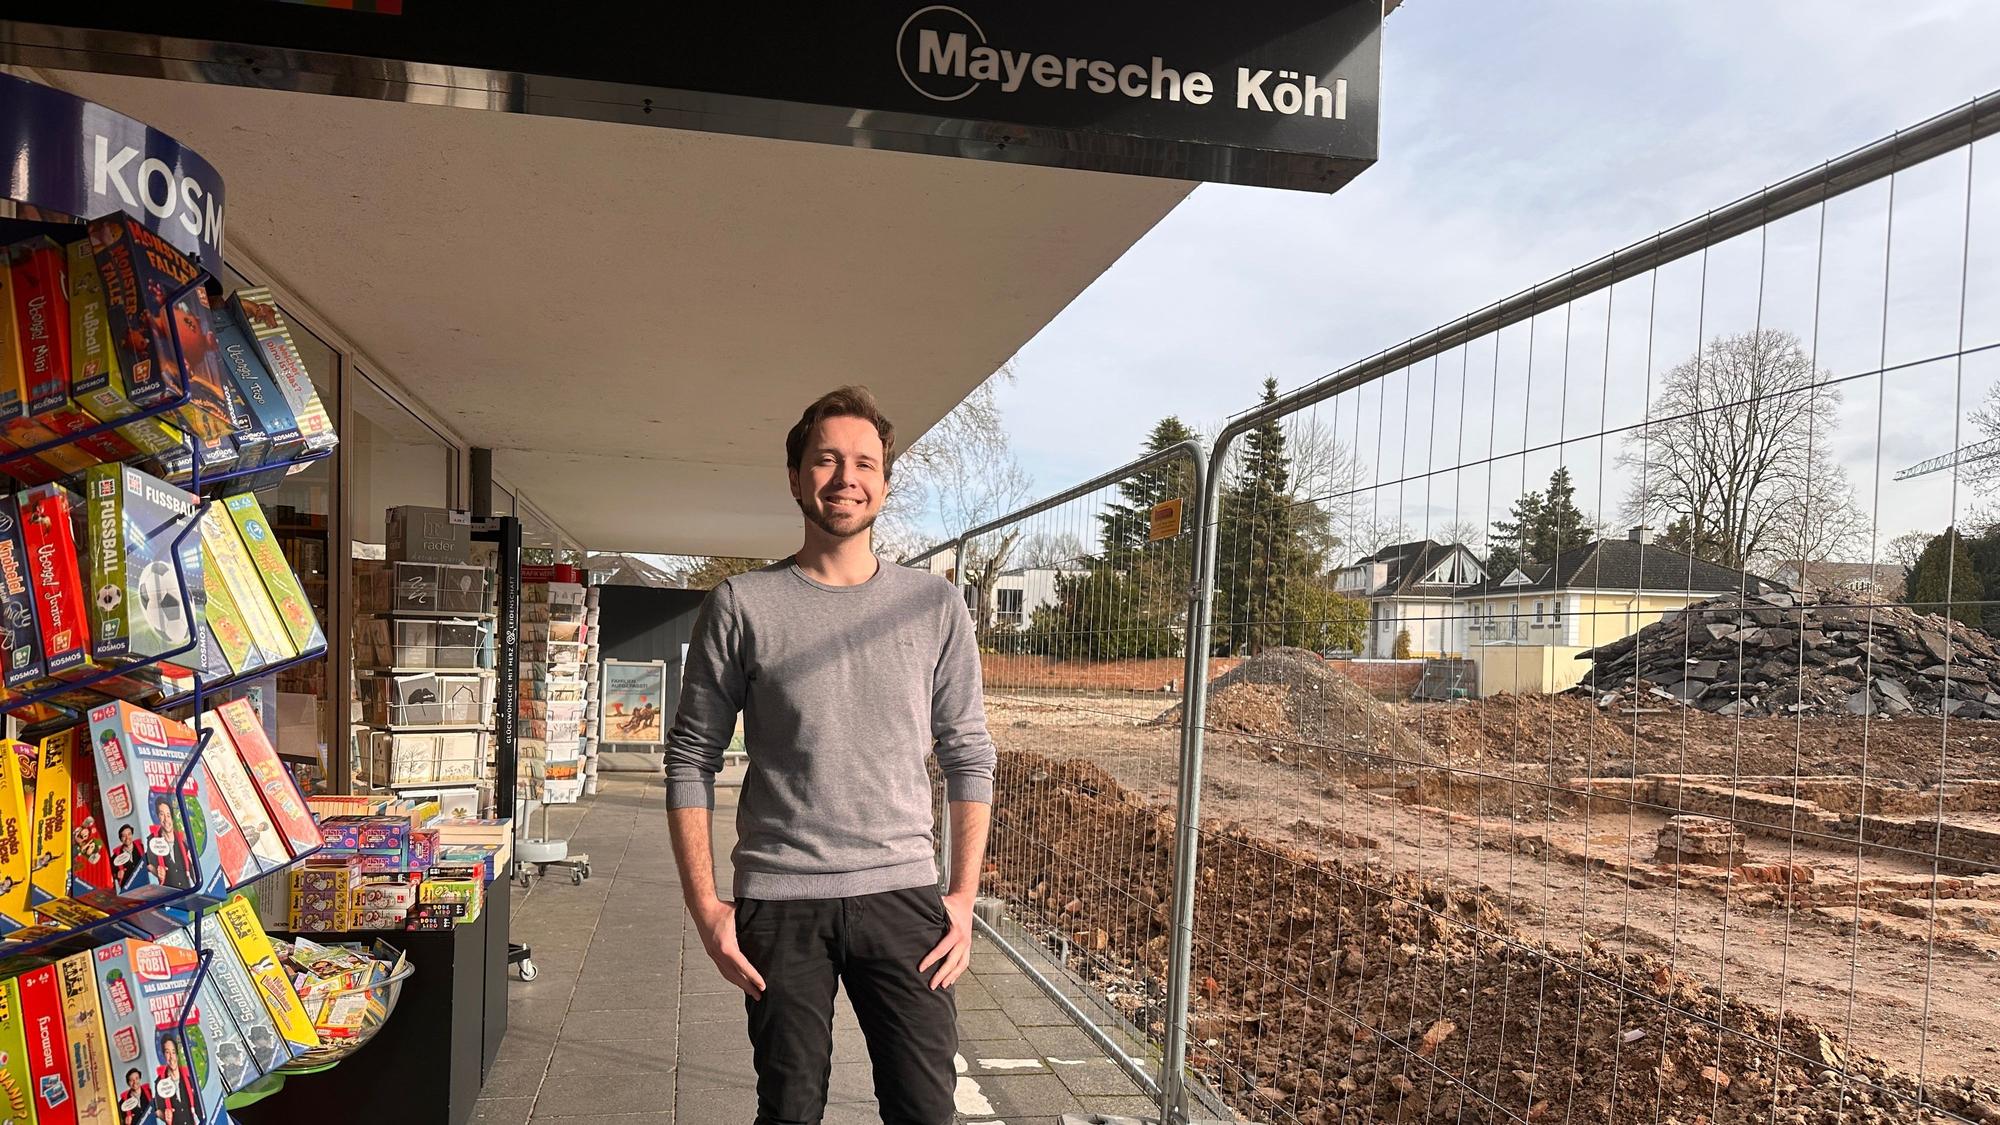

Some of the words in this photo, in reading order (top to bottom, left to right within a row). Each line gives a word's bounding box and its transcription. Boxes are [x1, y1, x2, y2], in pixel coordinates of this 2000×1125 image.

[918, 28, 1214, 105] Mayersche
[1236, 66, 1347, 120] Köhl
[28, 295, 49, 341] Ubongo!
[83, 301, 102, 356] Fußball
[32, 344, 49, 374] Mini
[226, 344, 259, 380] Ubongo!
[76, 377, 106, 392] KOSMOS
[131, 381, 161, 397] KOSMOS
[101, 499, 119, 576] FUSSBALL
[37, 543, 61, 588] Ubongo!
[44, 591, 63, 628] Junior
[50, 652, 82, 669] KOSMOS
[97, 641, 126, 654] KOSMOS
[198, 625, 208, 669] KOSMOS
[506, 646, 514, 666] HERZ
[9, 667, 40, 683] KOSMOS
[506, 667, 514, 681] MIT
[132, 722, 162, 740] TOBI
[143, 760, 172, 775] RUND
[147, 773, 167, 788] DIE
[43, 816, 55, 842] Hexe
[54, 797, 67, 834] Schoko
[5, 816, 19, 856] Schoko
[139, 956, 166, 973] TOBI
[149, 993, 176, 1011] RUND
[220, 971, 255, 1023] Scotland
[153, 1009, 172, 1025] DIE
[36, 1015, 54, 1069] memory
[0, 1067, 28, 1120] NANU?
